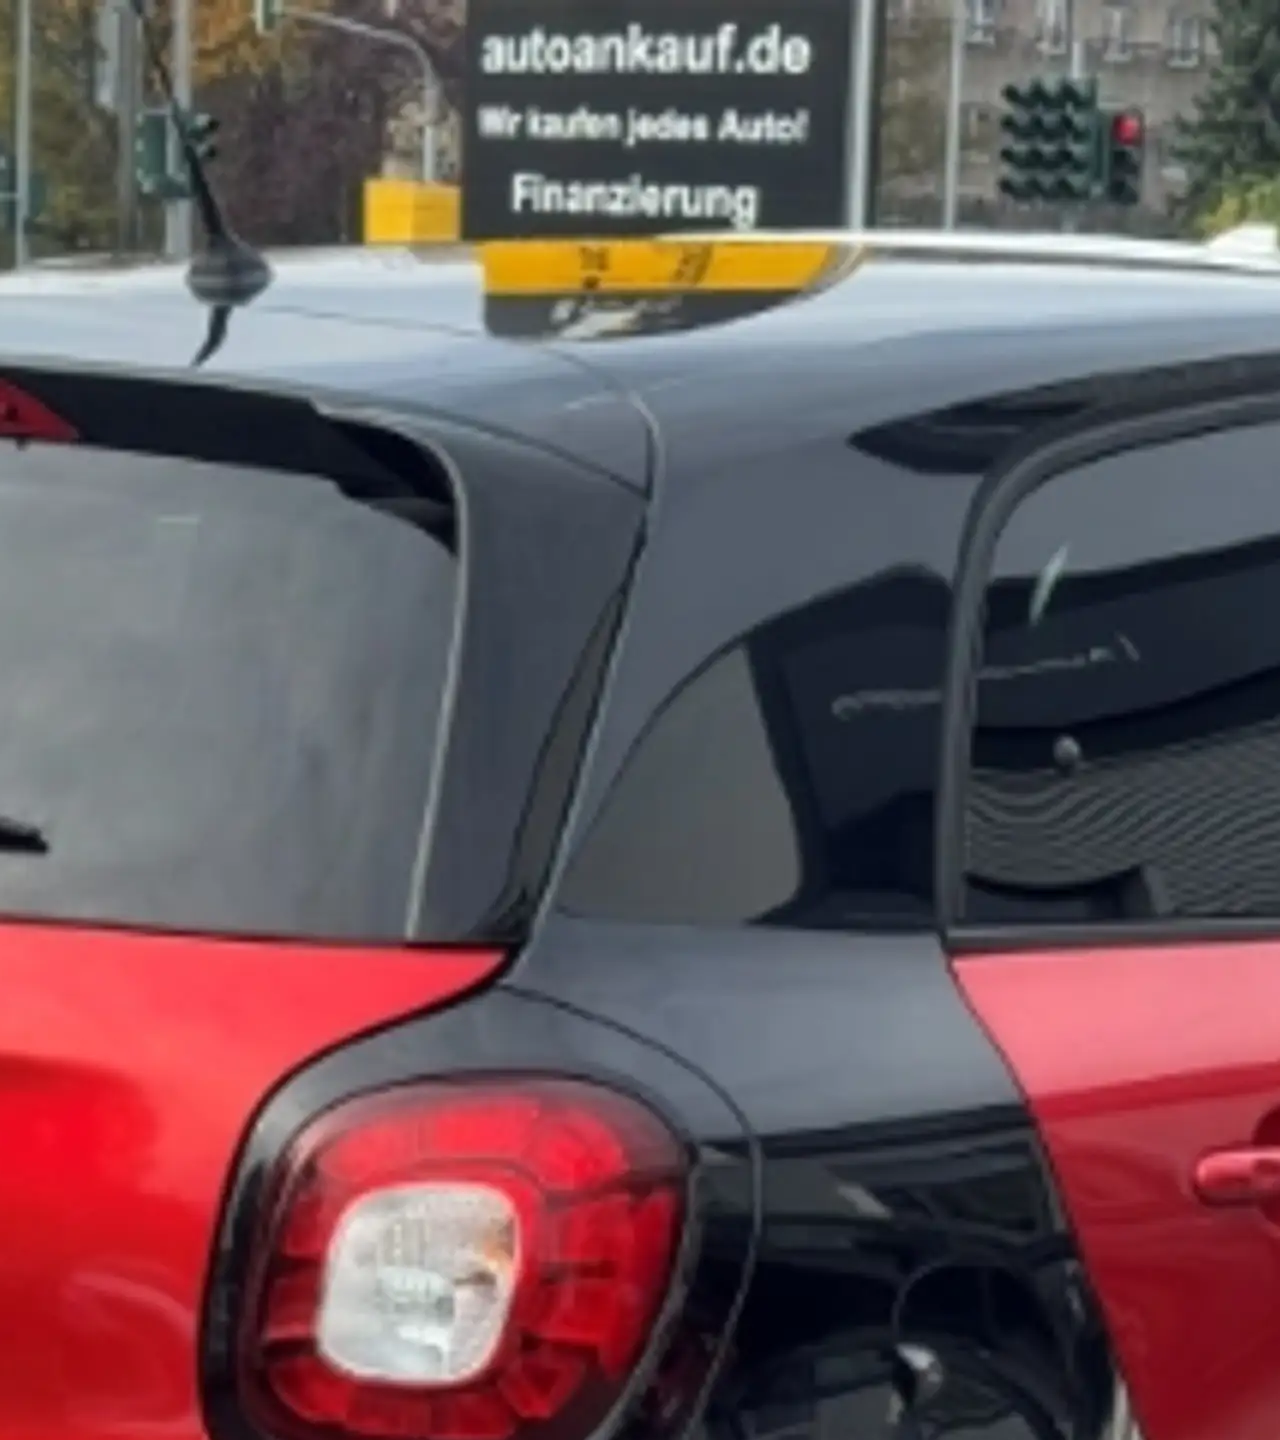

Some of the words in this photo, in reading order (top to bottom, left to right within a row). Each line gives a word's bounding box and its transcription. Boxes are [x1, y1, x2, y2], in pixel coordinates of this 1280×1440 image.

[481, 23, 812, 75] autoankauf.de
[477, 105, 522, 139] Wir
[526, 105, 619, 140] kaufen
[624, 107, 709, 148] jedes
[717, 107, 810, 143] Auto!
[512, 174, 758, 230] Finanzierung
